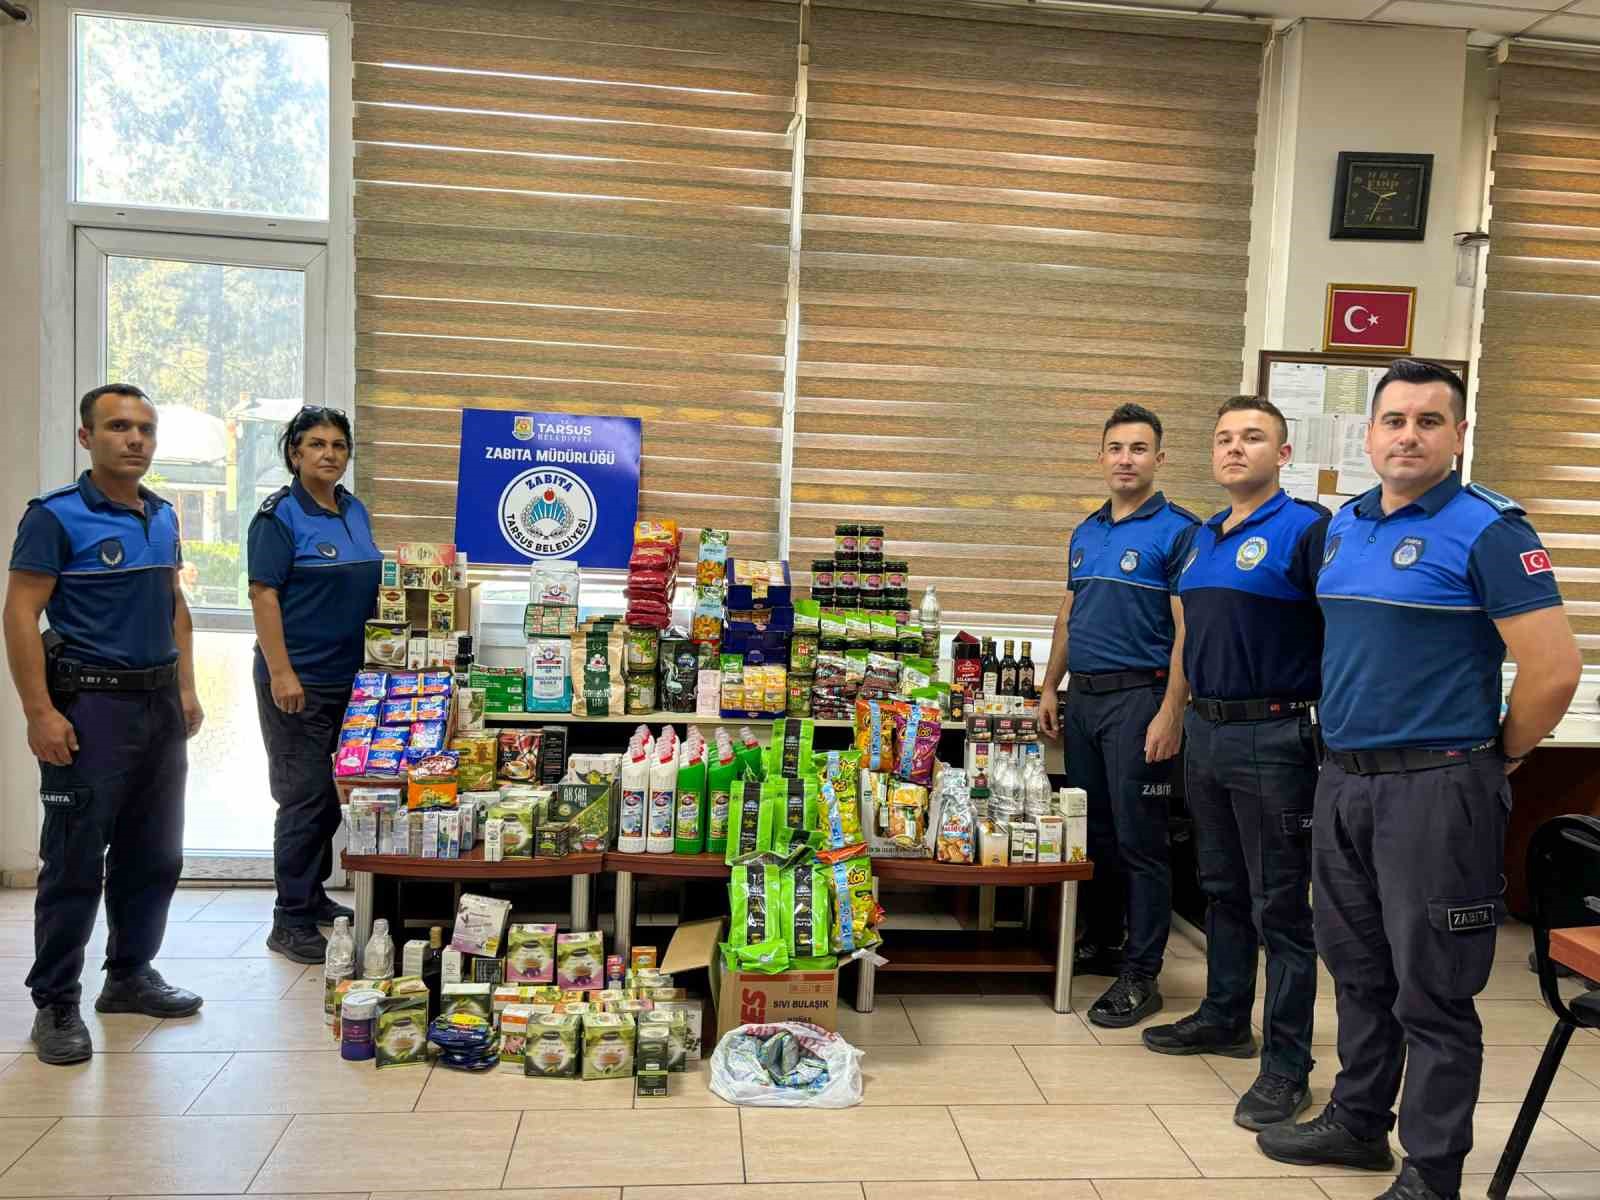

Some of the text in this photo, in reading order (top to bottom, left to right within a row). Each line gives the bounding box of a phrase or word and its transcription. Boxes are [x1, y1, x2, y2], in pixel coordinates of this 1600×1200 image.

[537, 423, 592, 436] TARSUS
[485, 446, 615, 465] ZABITA MÜDÜRLÜĞÜ
[525, 474, 574, 493] ZABITA
[506, 513, 589, 553] TARSUS BELEDİYESİ
[1142, 784, 1171, 796] ZABIT
[791, 999, 829, 1011] BULAŞIK
